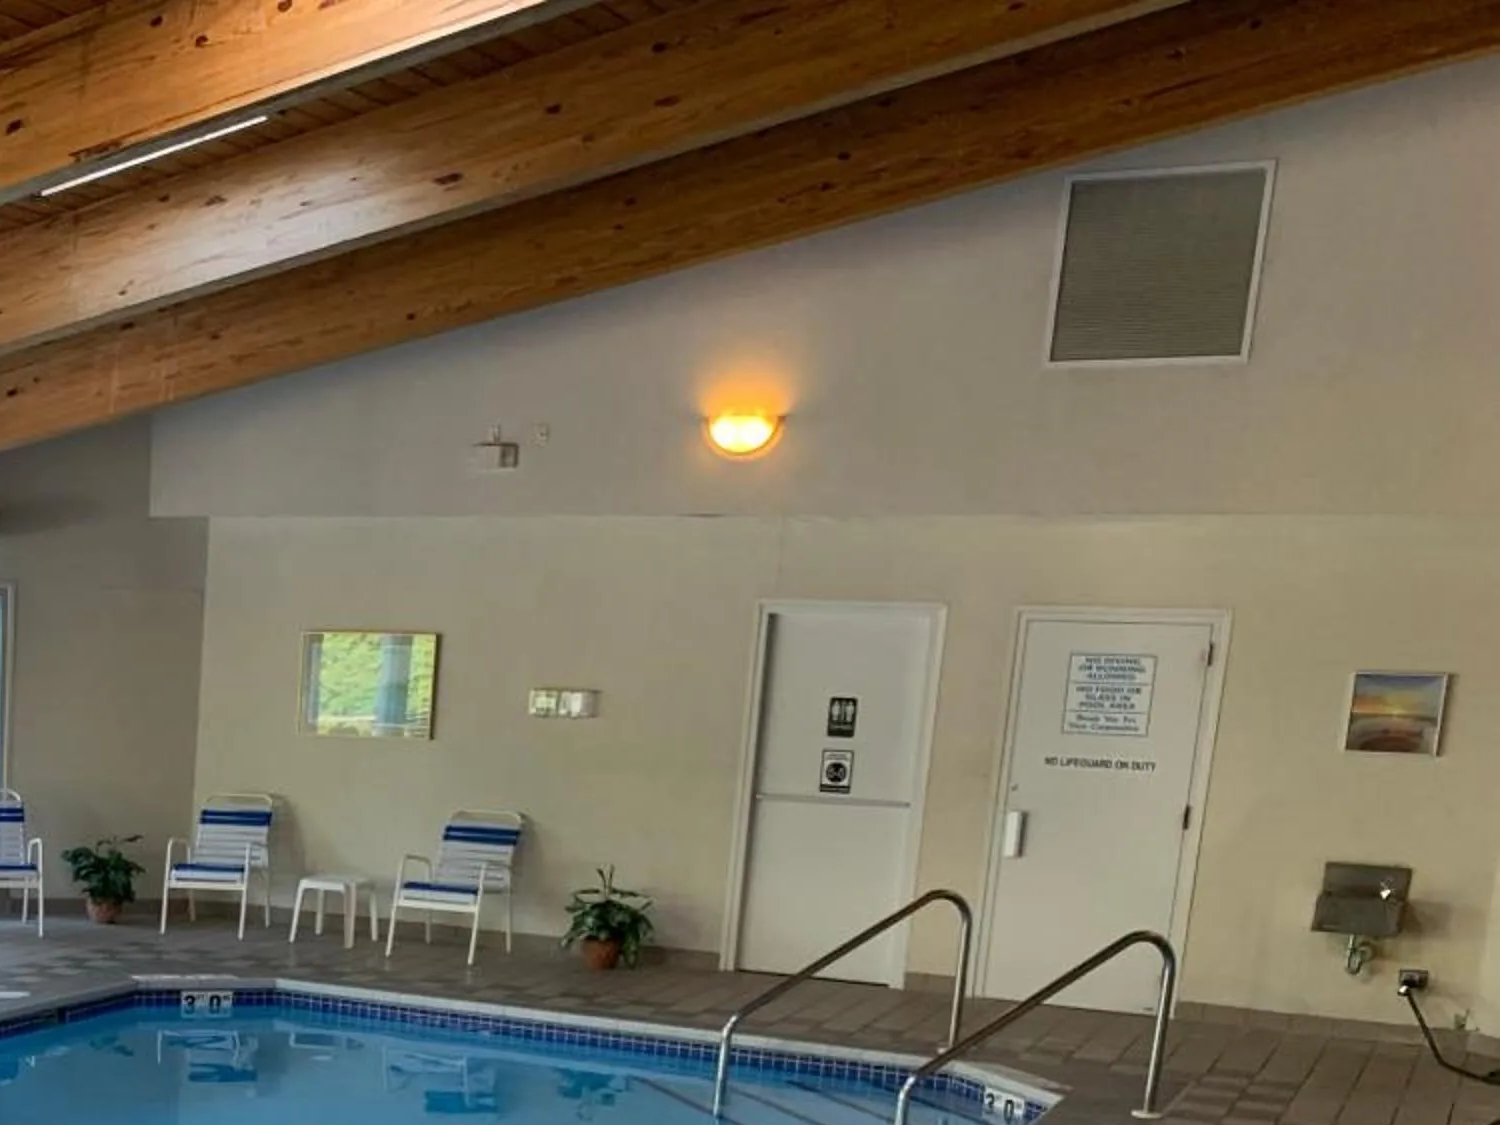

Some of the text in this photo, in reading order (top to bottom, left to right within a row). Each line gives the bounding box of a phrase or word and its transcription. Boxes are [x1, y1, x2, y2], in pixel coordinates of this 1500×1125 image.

[1103, 657, 1141, 665] DIVING
[1096, 665, 1146, 673] RUNNING
[1109, 702, 1136, 710] AREA
[1044, 756, 1157, 772] NO LIFEGUARD ON DUTY
